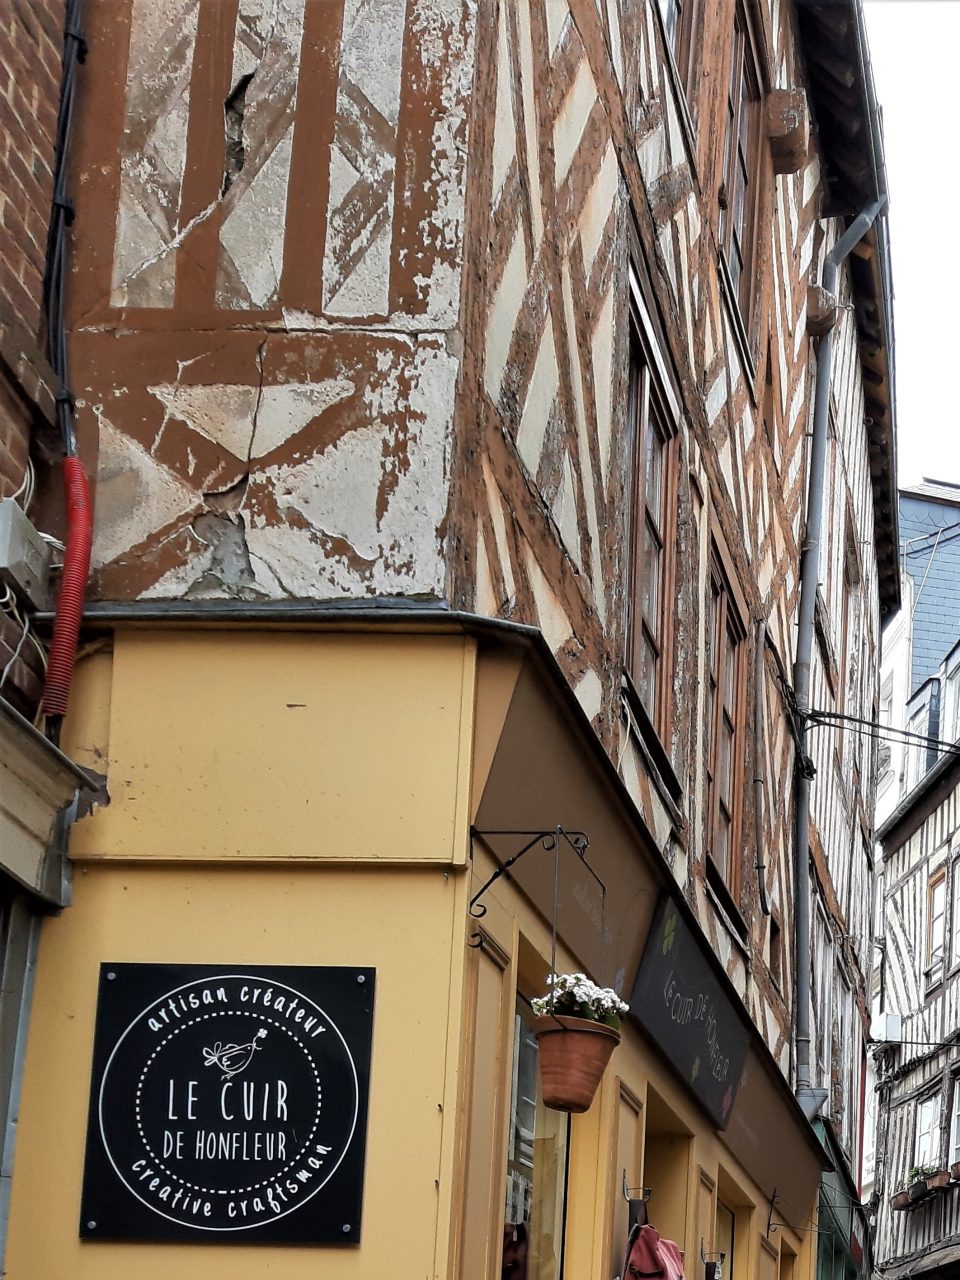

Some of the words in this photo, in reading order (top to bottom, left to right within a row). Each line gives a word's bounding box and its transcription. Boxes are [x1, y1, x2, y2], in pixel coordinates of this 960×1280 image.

[147, 985, 228, 1033] artisan
[239, 985, 327, 1039] créateur
[671, 993, 694, 1025] CUIR
[168, 1079, 199, 1121] LE
[220, 1079, 288, 1122] CUIR
[163, 1130, 185, 1160] DE
[195, 1130, 287, 1161] HONFLEUR
[131, 1158, 213, 1218] creative
[227, 1143, 333, 1219] craftsman
